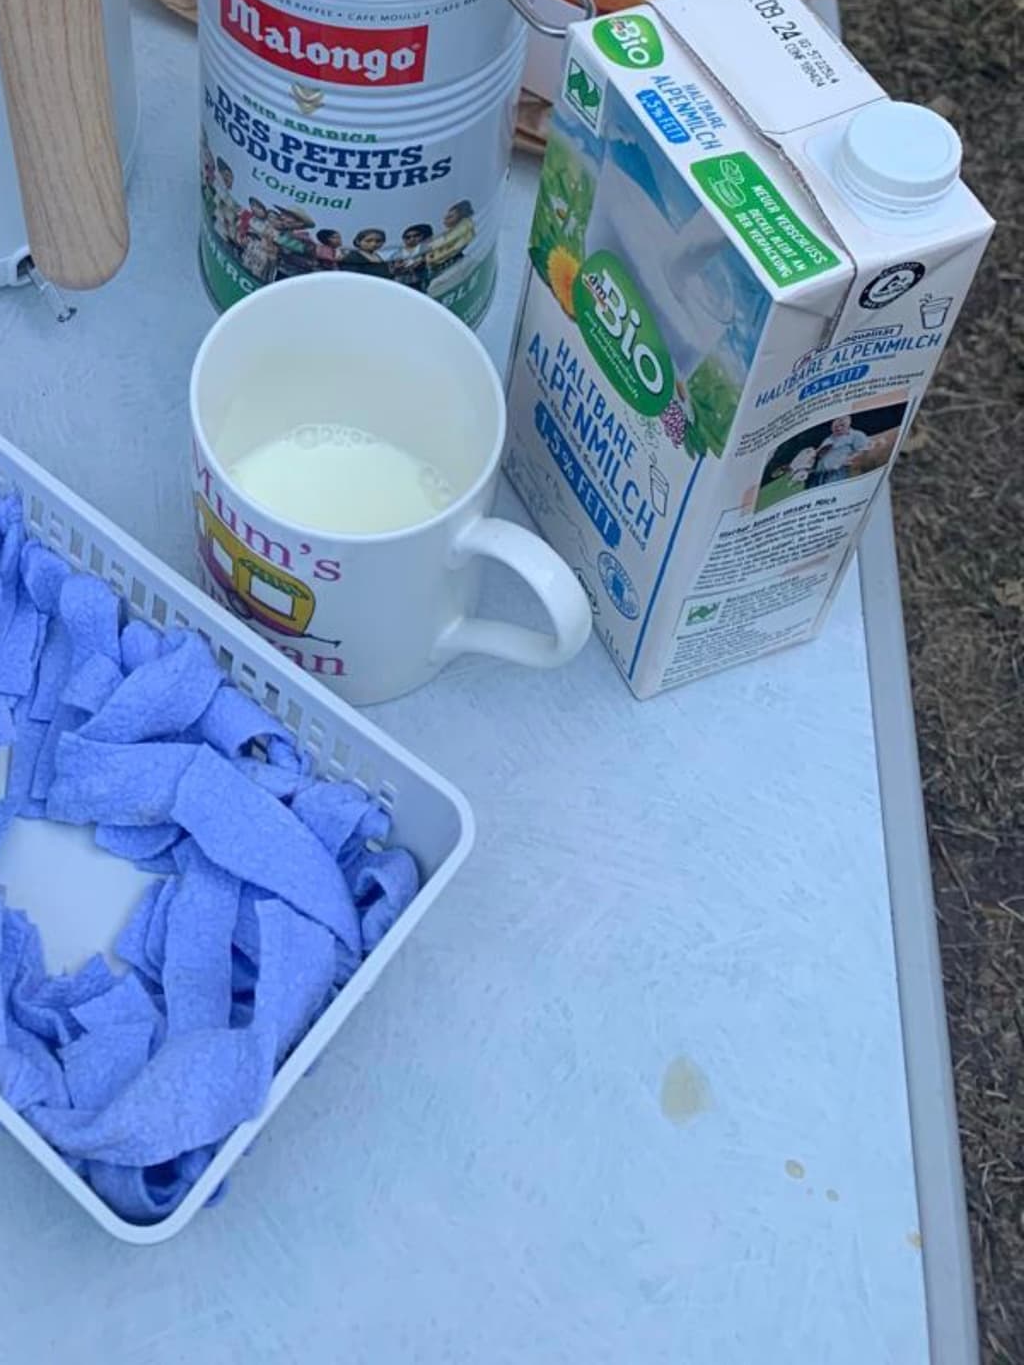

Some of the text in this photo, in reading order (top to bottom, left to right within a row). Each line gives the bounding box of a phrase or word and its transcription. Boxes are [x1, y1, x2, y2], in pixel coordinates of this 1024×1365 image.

[609, 18, 651, 65] Bio
[204, 84, 452, 190] PRODUCTEURS
[217, 84, 423, 170] DES PETITS
[650, 74, 723, 152] ALPENMILCH
[682, 82, 727, 131] HALTBARE
[251, 167, 353, 211] L'Original
[586, 273, 608, 302] dm
[593, 268, 664, 394] Bio
[556, 337, 638, 468] HALTBARE
[756, 357, 825, 409] HALTBARE
[829, 333, 942, 365] ALPENMILCH
[528, 332, 655, 540] ALPENMILCH
[576, 473, 614, 537] FETT
